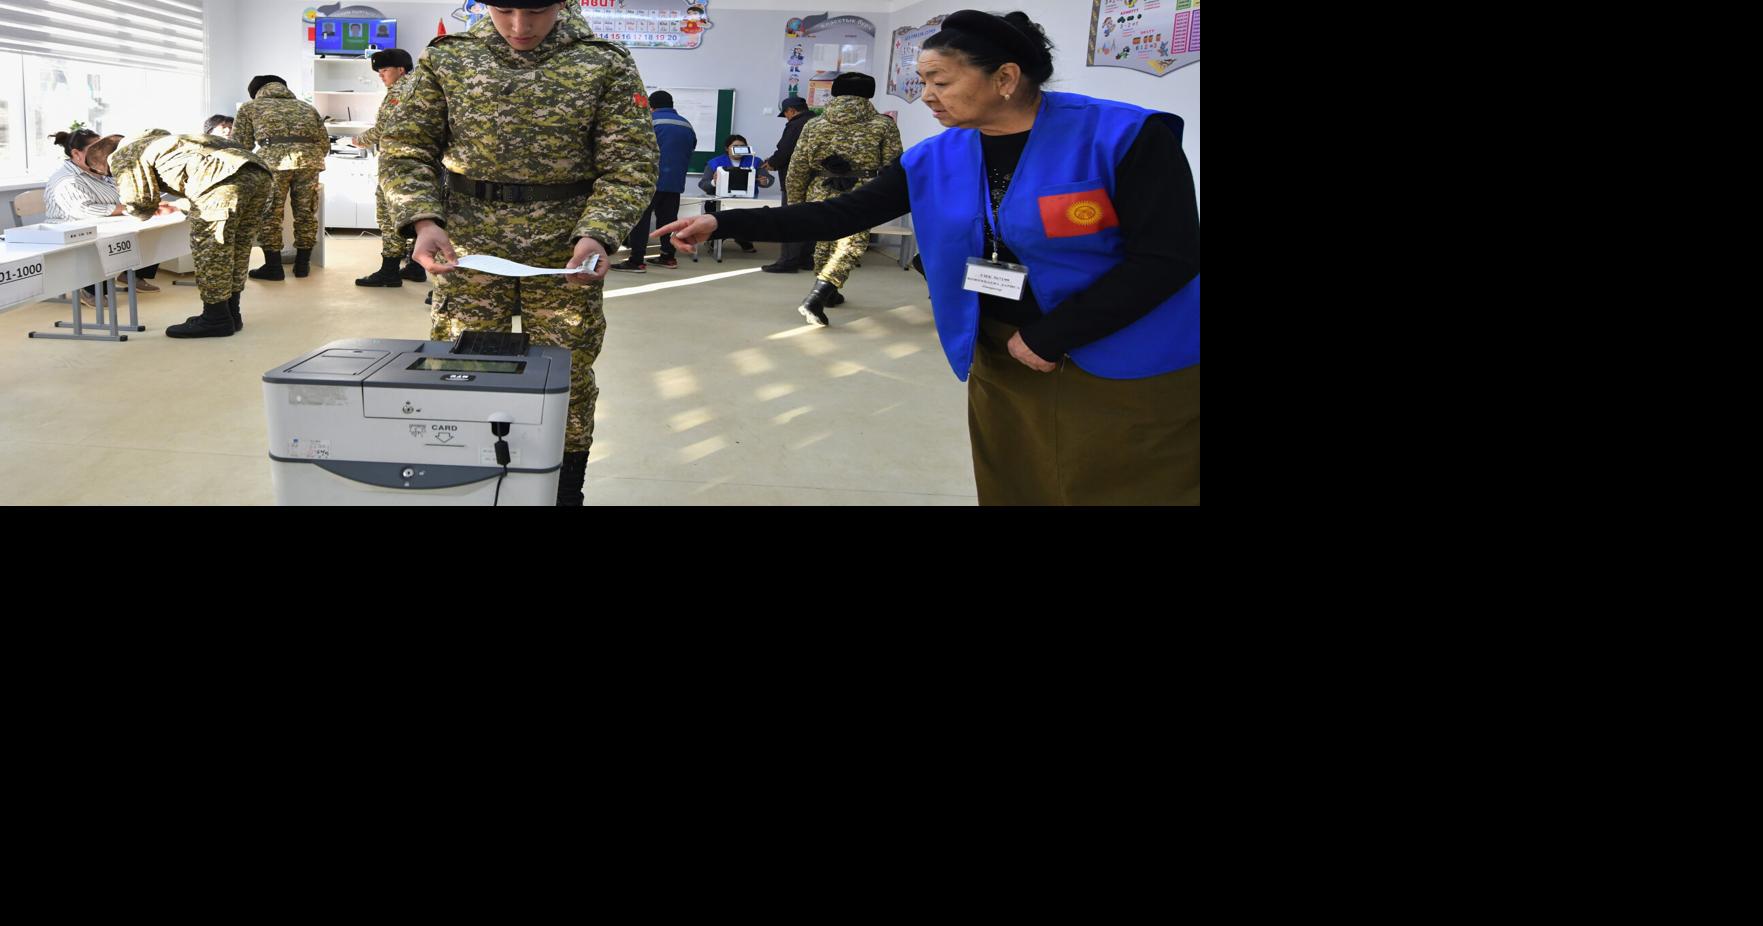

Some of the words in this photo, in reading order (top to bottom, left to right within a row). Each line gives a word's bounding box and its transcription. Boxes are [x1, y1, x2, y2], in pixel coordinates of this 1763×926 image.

[108, 240, 131, 253] 1-500
[0, 263, 42, 282] 01-1000
[431, 424, 458, 432] CARD
